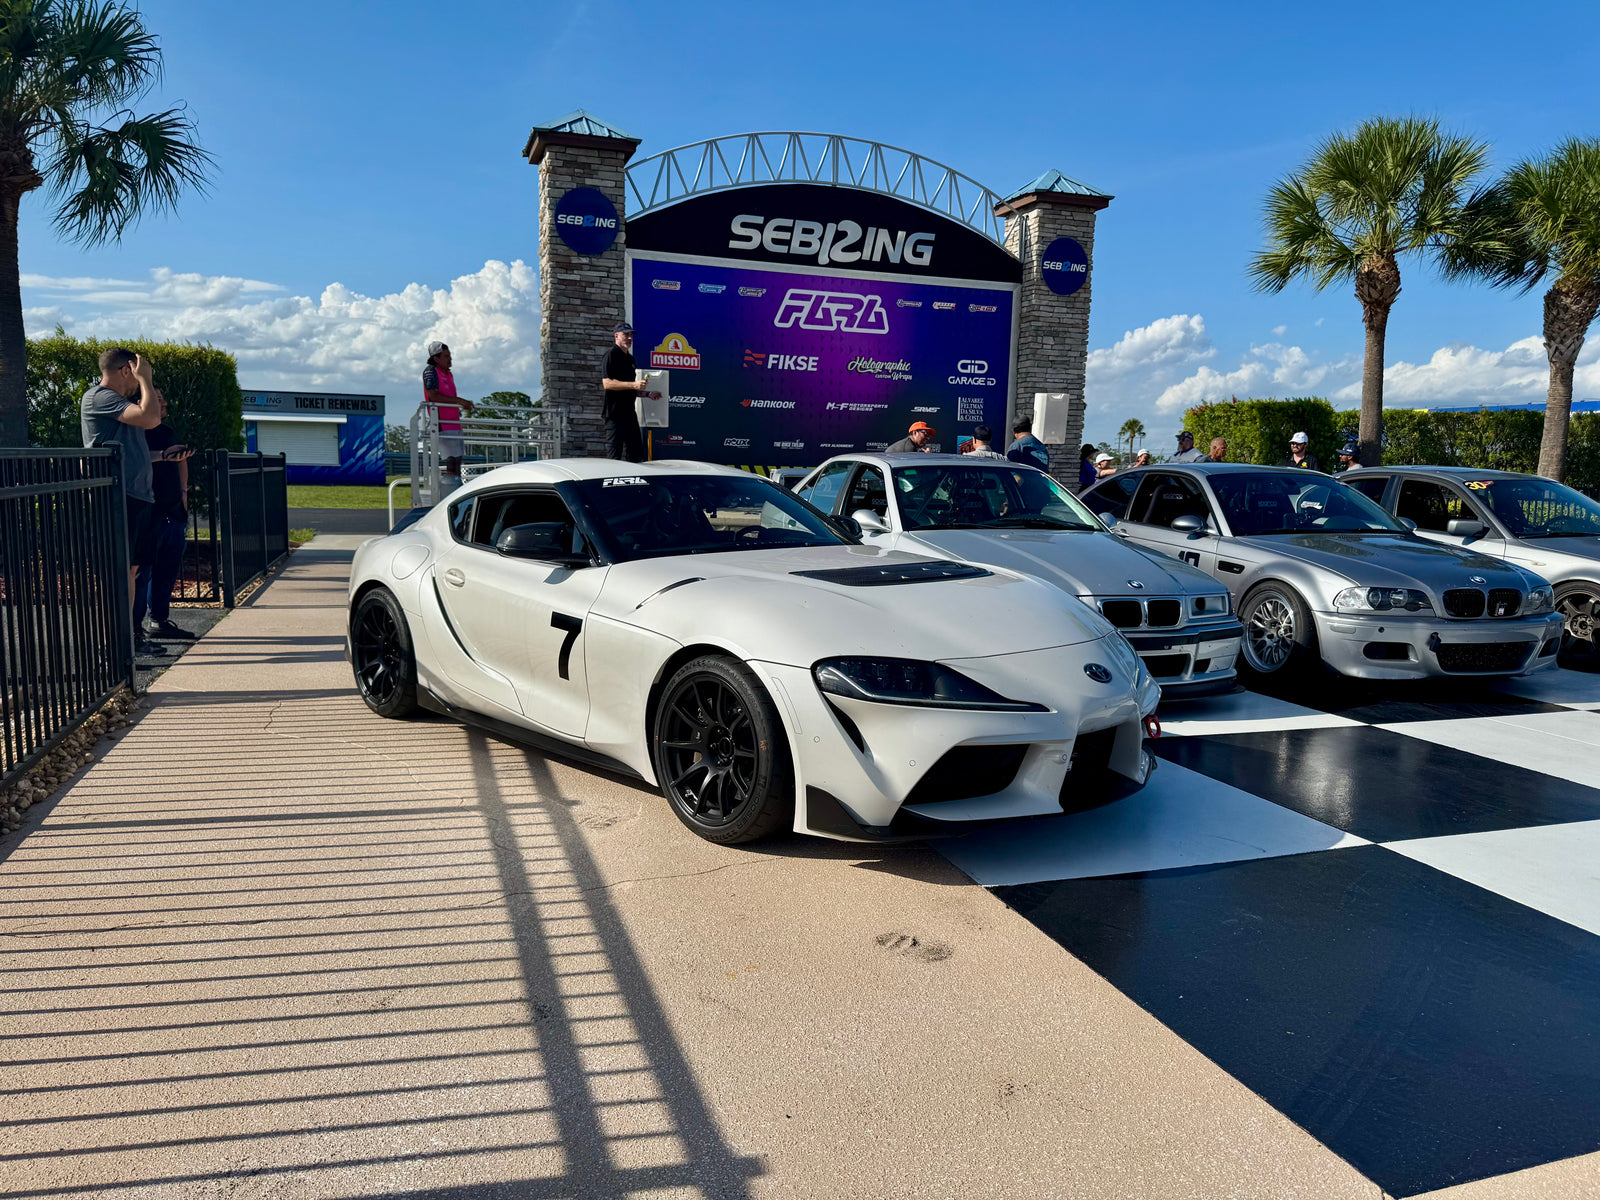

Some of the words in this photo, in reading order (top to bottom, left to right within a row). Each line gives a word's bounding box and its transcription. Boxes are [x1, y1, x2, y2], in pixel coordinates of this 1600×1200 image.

[652, 354, 698, 367] MISSION
[767, 354, 819, 371] FIKSE
[847, 355, 911, 374] Holographic
[948, 376, 986, 386] GARAGE
[294, 396, 325, 410] TICKET
[328, 398, 377, 411] RENEWALS
[1464, 481, 1487, 490] 30
[550, 611, 583, 681] 7
